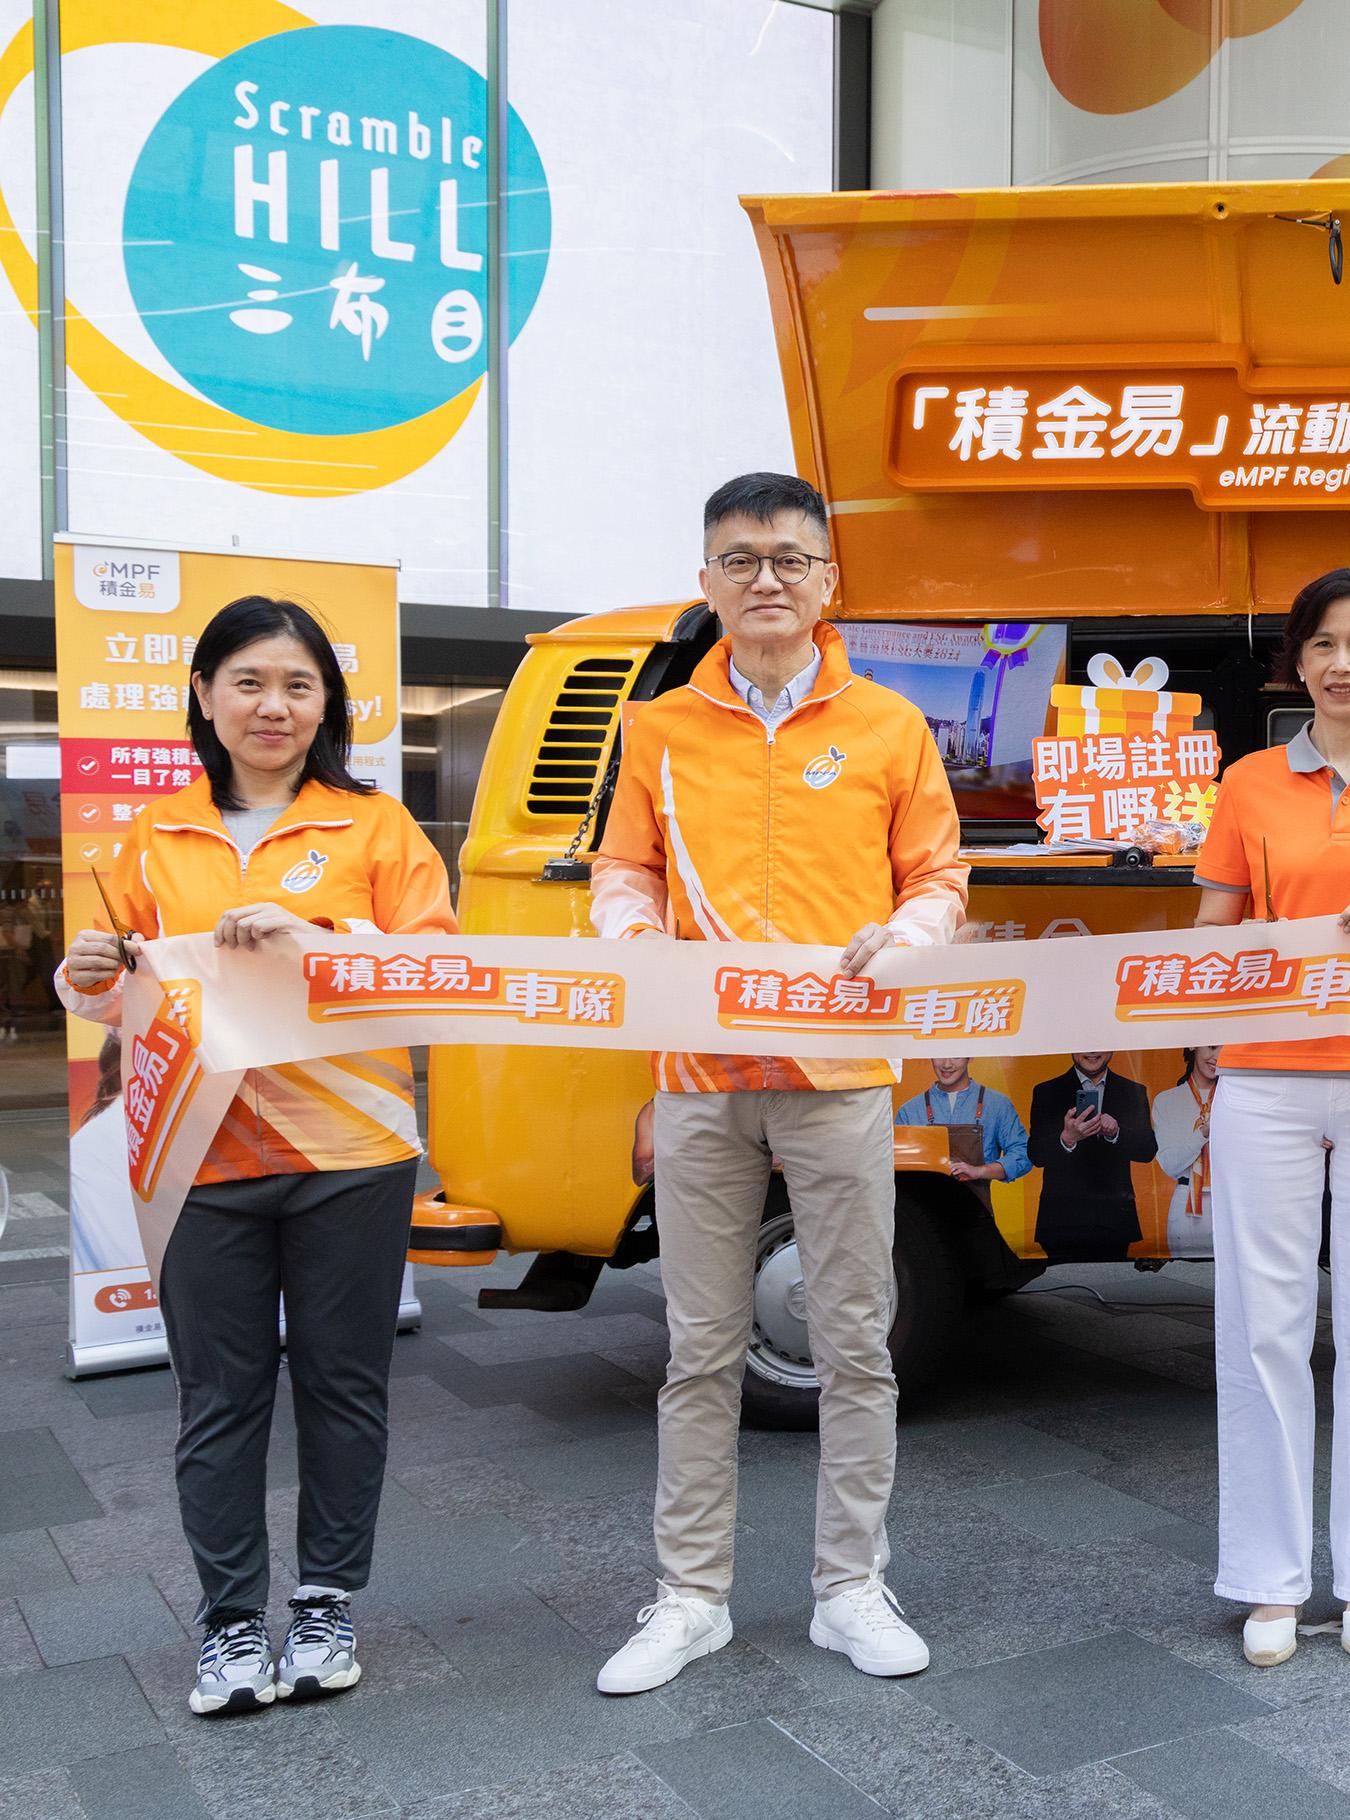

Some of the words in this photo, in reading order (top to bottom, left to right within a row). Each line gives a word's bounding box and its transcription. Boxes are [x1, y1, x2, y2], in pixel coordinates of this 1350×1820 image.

[233, 80, 484, 170] Scramble
[233, 143, 484, 273] HILL
[228, 261, 484, 364] 三布目
[1218, 466, 1290, 487] eMPF
[99, 580, 156, 599] 積金易
[79, 681, 190, 712] 處理強
[111, 768, 192, 786] 一目了然
[1036, 735, 1218, 783] 即場註冊
[309, 956, 616, 1021] 「積金易」車隊
[719, 972, 1016, 1034] 「積金易」車隊
